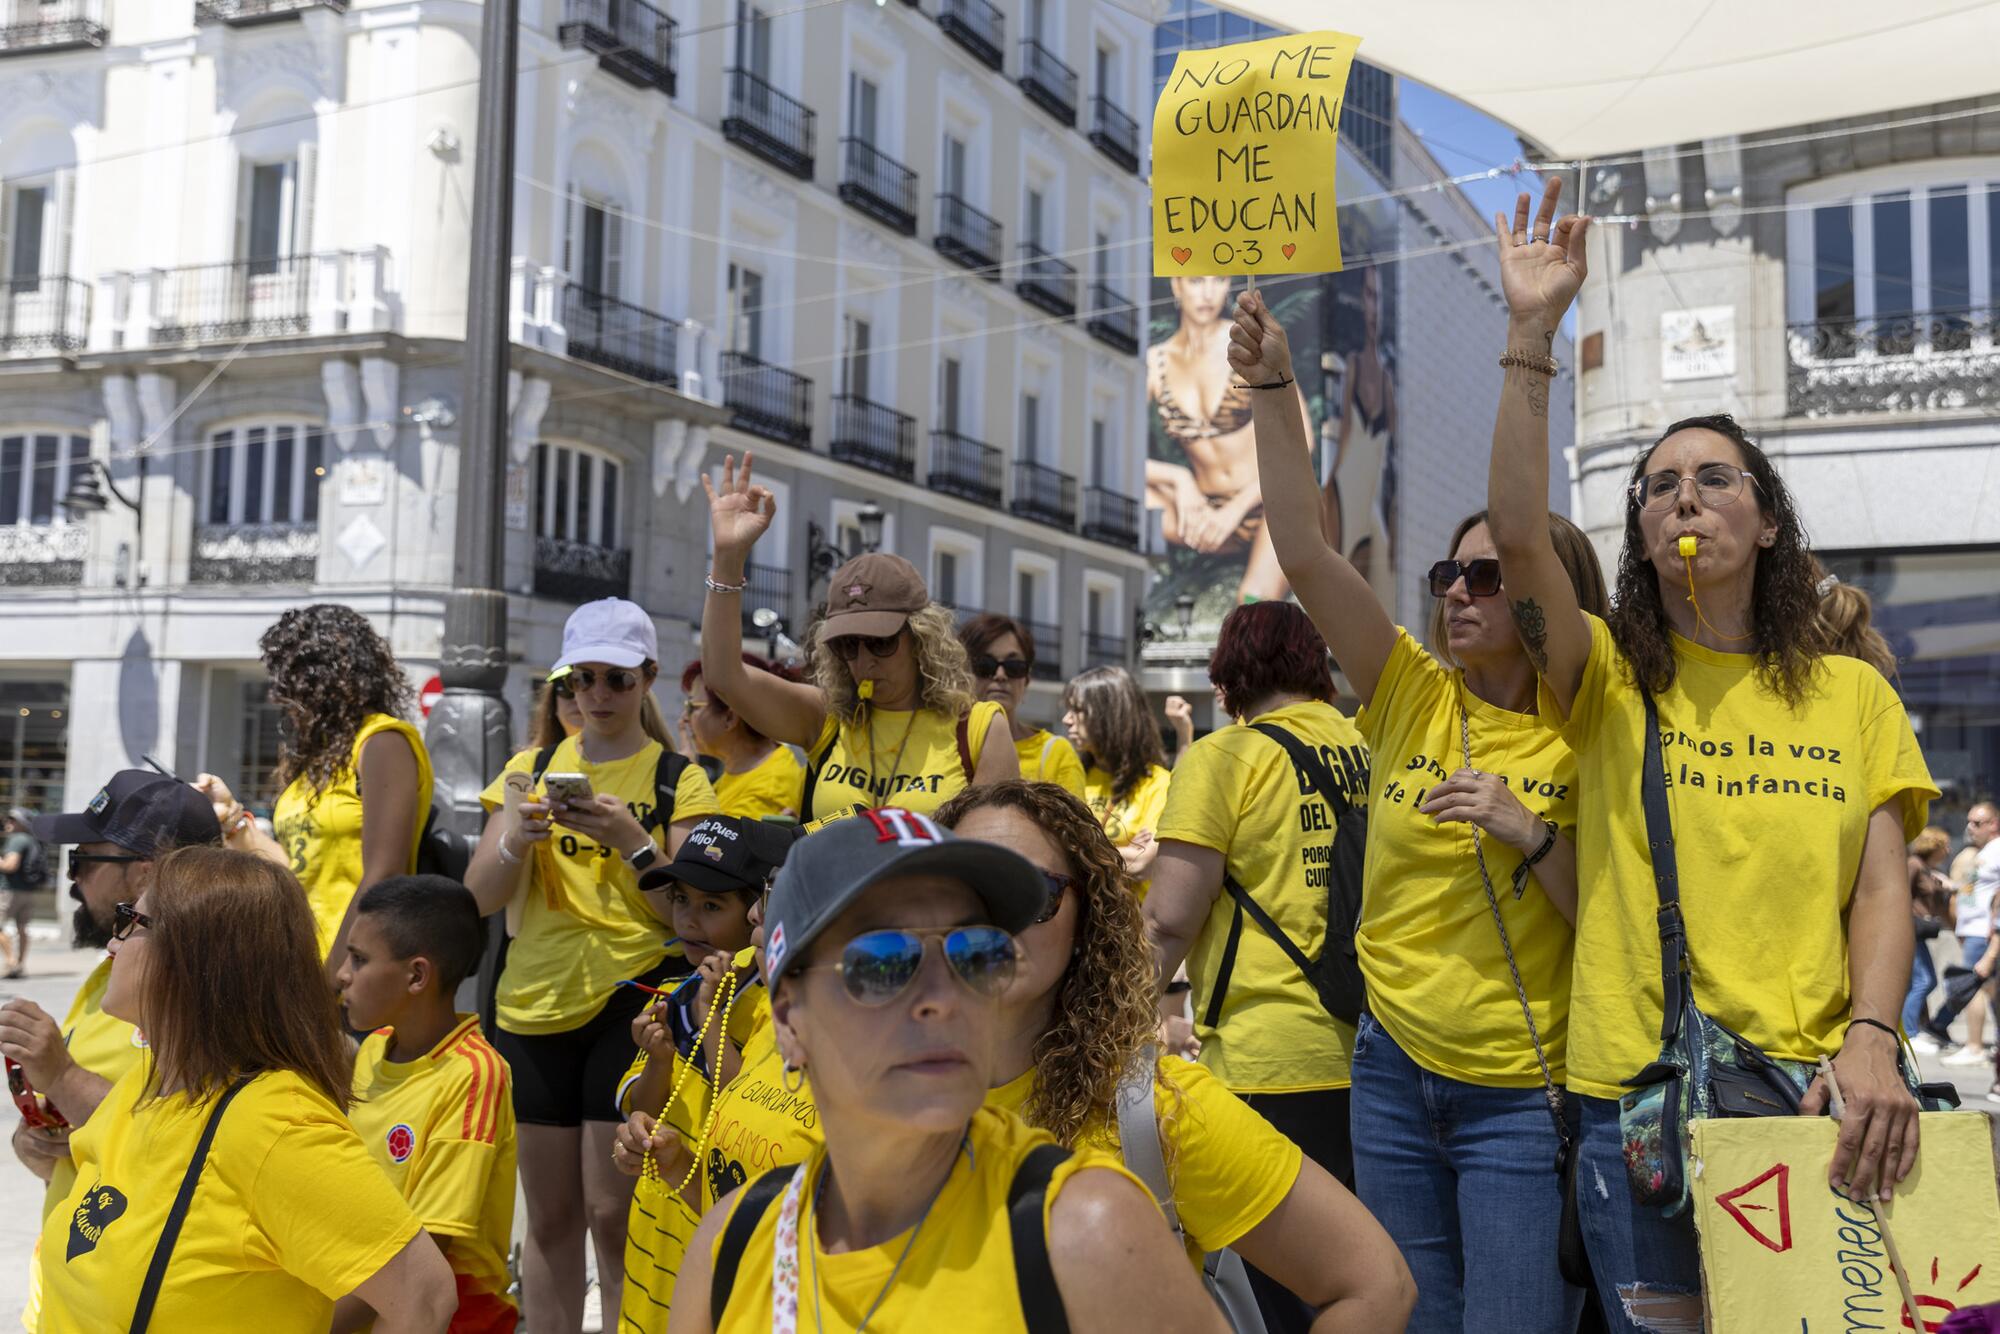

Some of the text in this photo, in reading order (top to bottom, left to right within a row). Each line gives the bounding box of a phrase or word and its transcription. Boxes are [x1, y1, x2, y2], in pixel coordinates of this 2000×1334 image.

[1174, 45, 1336, 93] NO ME
[1217, 143, 1274, 183] ME
[1164, 192, 1317, 233] EDUCAN
[1213, 240, 1263, 265] 0-3
[1749, 734, 1774, 757] la
[1788, 743, 1842, 764] voz
[823, 763, 944, 798] DIGNITAT
[1384, 780, 1405, 803] de
[1522, 777, 1569, 801] voz
[1679, 763, 1705, 789] la
[1717, 774, 1846, 804] infancia
[710, 821, 739, 841] Pues
[1300, 803, 1332, 832] DEL
[741, 1080, 816, 1130] GUARDAMOS
